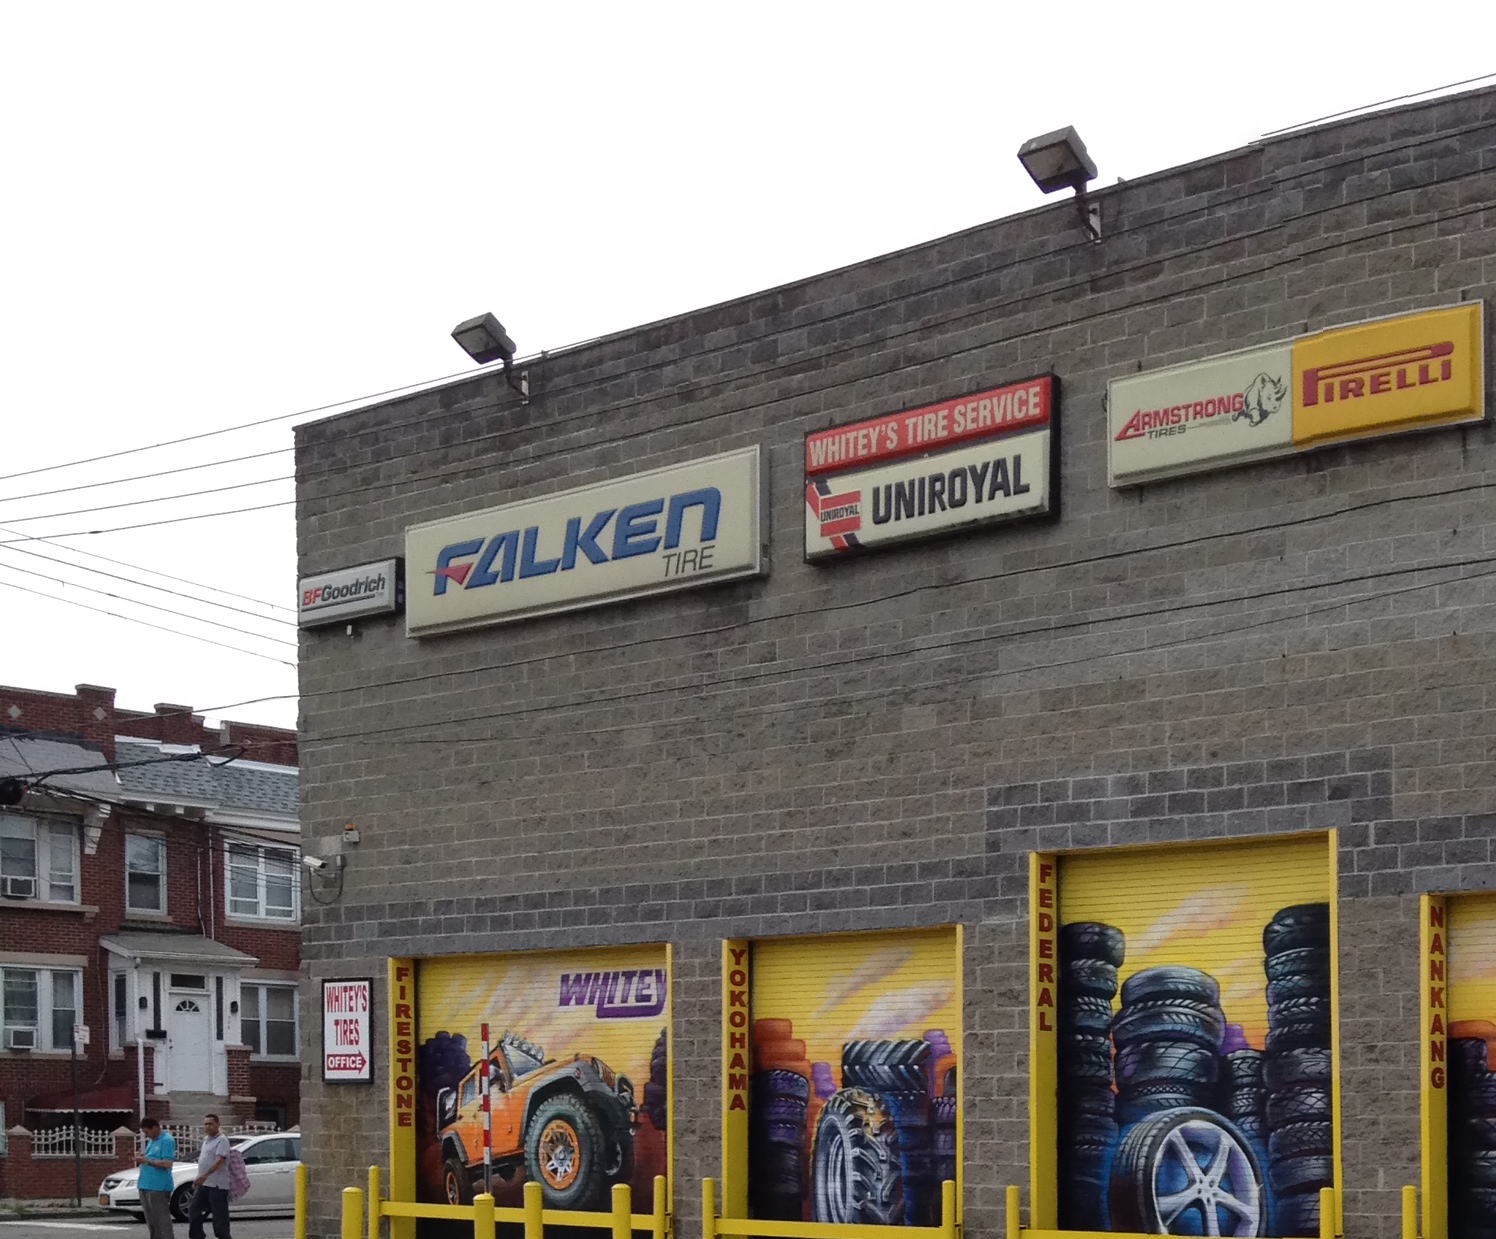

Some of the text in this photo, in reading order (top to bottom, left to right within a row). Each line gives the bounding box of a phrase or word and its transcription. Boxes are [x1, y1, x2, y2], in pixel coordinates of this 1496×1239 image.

[1303, 341, 1454, 407] PIRELLI
[810, 387, 1040, 467] WHITEY'S TIRE SERVICE
[1115, 392, 1244, 441] ARMSTRONG
[1148, 424, 1187, 440] TIRES
[821, 505, 859, 523] UNIROYAL
[873, 454, 1030, 525] UNIROYAL
[430, 487, 722, 596] FALKEN
[662, 545, 716, 578] TIRE
[303, 573, 386, 606] BFGoodrich
[1037, 864, 1054, 1032] FEDERAL
[326, 984, 367, 1013] WHITEY'S
[1429, 905, 1446, 1090] NANKANG
[334, 1018, 360, 1046] TIRES
[395, 966, 414, 1128] FIRESTONE
[728, 949, 747, 1112] YOKOHAMA
[328, 1056, 362, 1068] OFFICE
